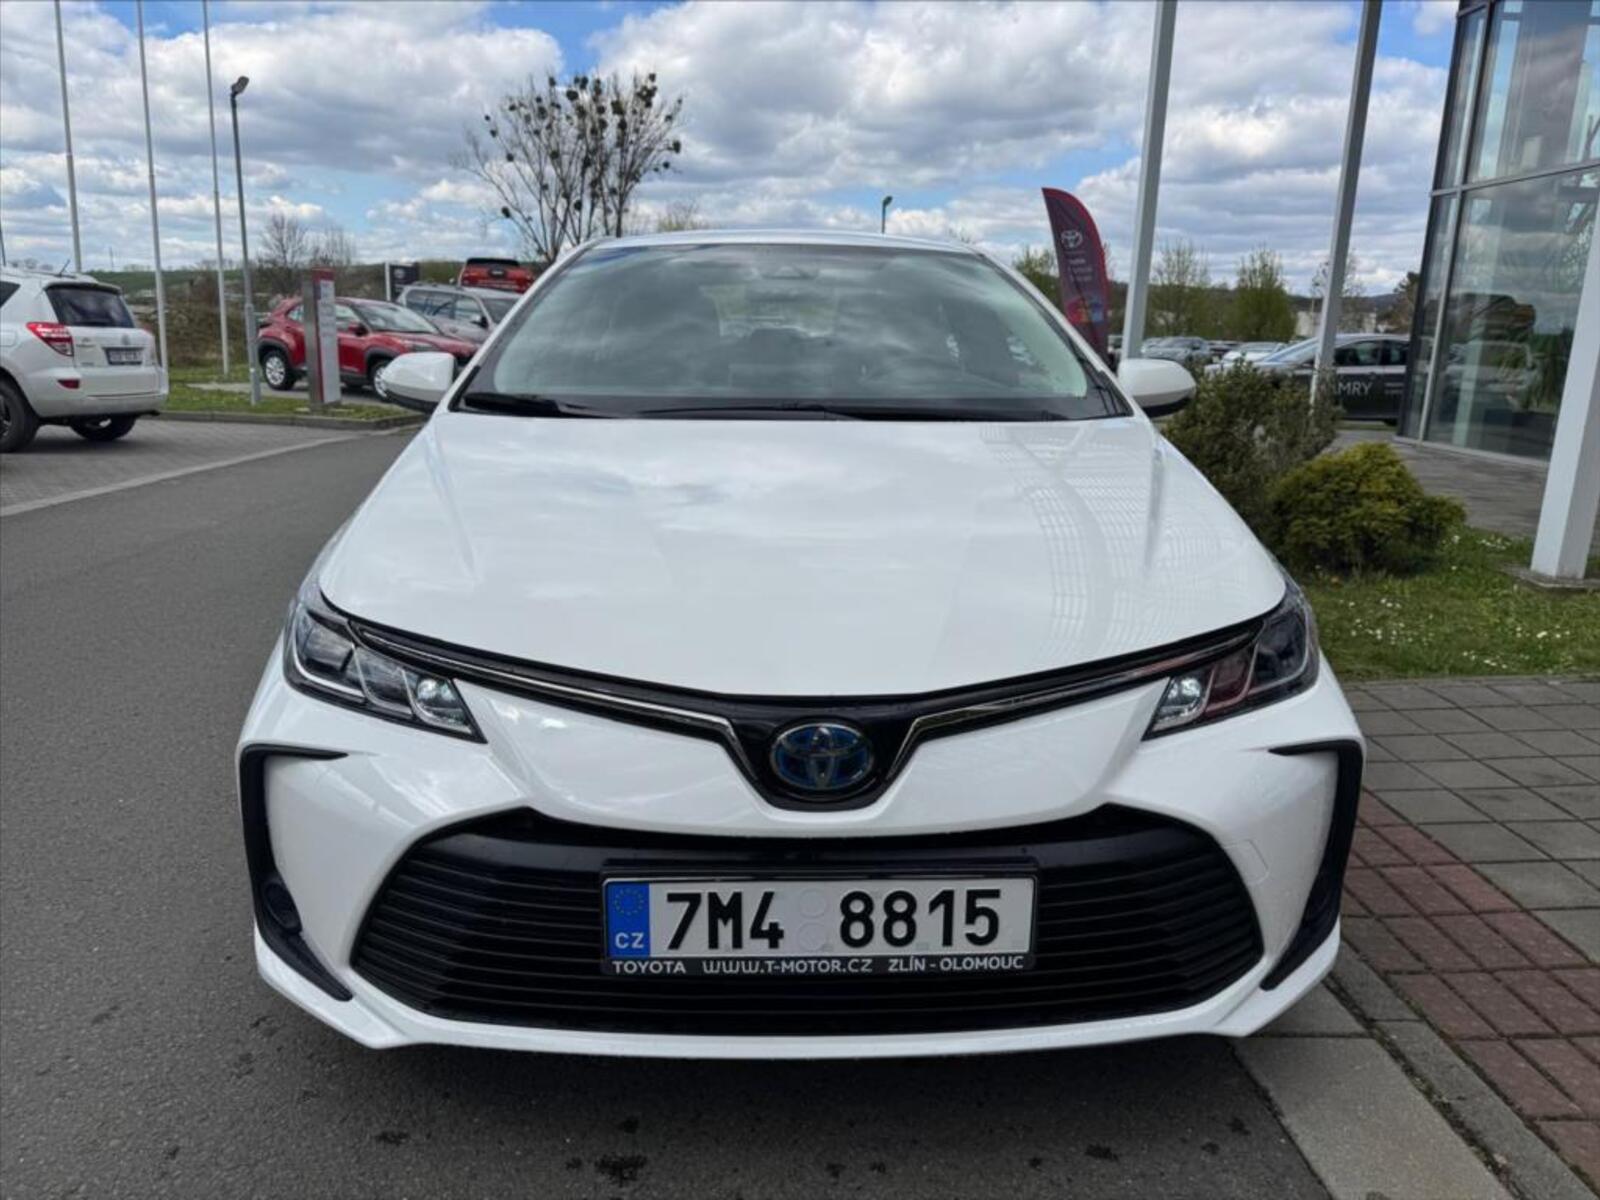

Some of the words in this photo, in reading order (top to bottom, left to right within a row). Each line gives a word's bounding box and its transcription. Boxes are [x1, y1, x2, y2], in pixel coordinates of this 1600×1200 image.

[666, 891, 785, 950] 7M4
[839, 889, 1001, 948] 8815
[614, 932, 645, 949] CZ
[612, 960, 687, 975] TOYOTA
[702, 958, 873, 975] WWW.T-MOTOR.CZ
[888, 955, 926, 972] ZLÍN
[939, 955, 1025, 971] OLOMOUC
